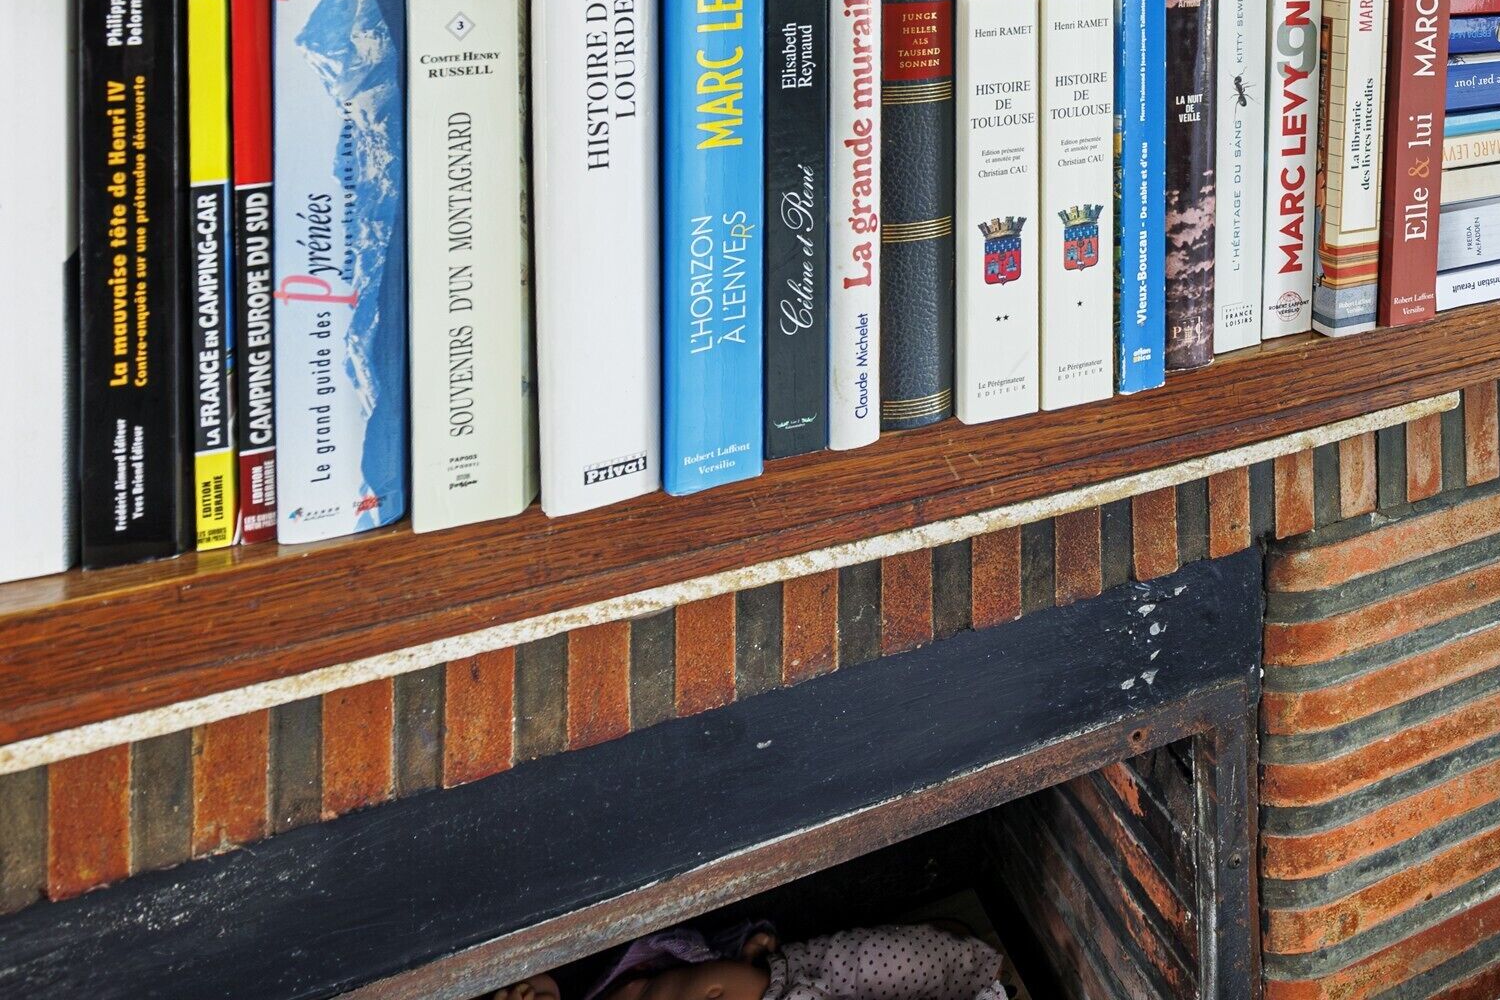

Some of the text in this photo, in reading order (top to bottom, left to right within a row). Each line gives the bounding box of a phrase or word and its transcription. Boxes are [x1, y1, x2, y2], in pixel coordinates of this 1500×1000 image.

[902, 12, 938, 23] JUNGK
[1054, 18, 1109, 31] Henri RAMET
[902, 25, 938, 35] HELLER
[912, 37, 929, 46] ALS
[975, 25, 1033, 39] Henri RAMET
[781, 22, 797, 90] Elisabeth
[797, 24, 816, 88] Reynaud
[898, 47, 941, 58] TAUSEND
[1236, 32, 1244, 64] KITTY
[428, 64, 494, 79] RUSSELL
[899, 58, 940, 69] SONNEN
[975, 80, 1031, 96] HISTOIRE
[1055, 72, 1108, 87] HISTOIRE
[1454, 75, 1477, 89] jour
[1477, 74, 1494, 86] par
[586, 30, 610, 172] HISTOIRE
[695, 45, 744, 150] MARC
[995, 98, 1012, 111] DE
[1073, 89, 1090, 101] DE
[1187, 93, 1203, 105] NUIT
[1050, 102, 1111, 120] TOULOUSE
[1178, 113, 1201, 123] VEILLE
[1185, 104, 1195, 114] DE
[970, 112, 1035, 130] TOULOUSE
[1351, 100, 1362, 152] librairie
[1360, 77, 1374, 191] des livres interdits
[978, 165, 1028, 179] Christian CAU
[1057, 154, 1105, 168] Christian CAU
[1278, 64, 1309, 275] MARC LEVY
[447, 110, 473, 255] MONTAGNARD
[843, 118, 878, 235] grande
[1404, 112, 1433, 243] Elle lui
[1231, 164, 1242, 272] L'HÉRITAGE DU
[107, 80, 128, 387] La mauvaise tête de Henri IV
[132, 74, 150, 388] Contre-enquête une prétendue découverte
[779, 163, 816, 336] Céline René
[1136, 180, 1148, 326] Vieux-Boucau sable
[843, 241, 872, 290] La
[448, 263, 473, 315] D'UN
[690, 214, 714, 355] L'HORIZON
[716, 210, 756, 345] À L'ENVERS
[1452, 280, 1476, 294] Ferault
[197, 192, 221, 428] FRANCE CAMPING-CAR
[1393, 292, 1434, 305] Robert Laffont
[1402, 305, 1425, 315] Versilio
[245, 191, 274, 446] CAMPING EUROPE DU SUD
[309, 310, 332, 340] des
[1225, 309, 1253, 320] FRANCE
[1225, 316, 1253, 328] LOISIRS
[309, 348, 336, 396] guide
[854, 312, 869, 420] Claude Michelet
[1057, 367, 1104, 381] EDITEUR
[449, 324, 474, 438] SOUVENIRS
[977, 384, 1026, 398] EDITEUR
[309, 403, 336, 455] grand
[683, 441, 751, 466] Robert Laffont
[310, 463, 332, 484] Le
[585, 457, 646, 485] Privat
[698, 458, 736, 475] Versilio
[201, 480, 212, 519] EDITION
